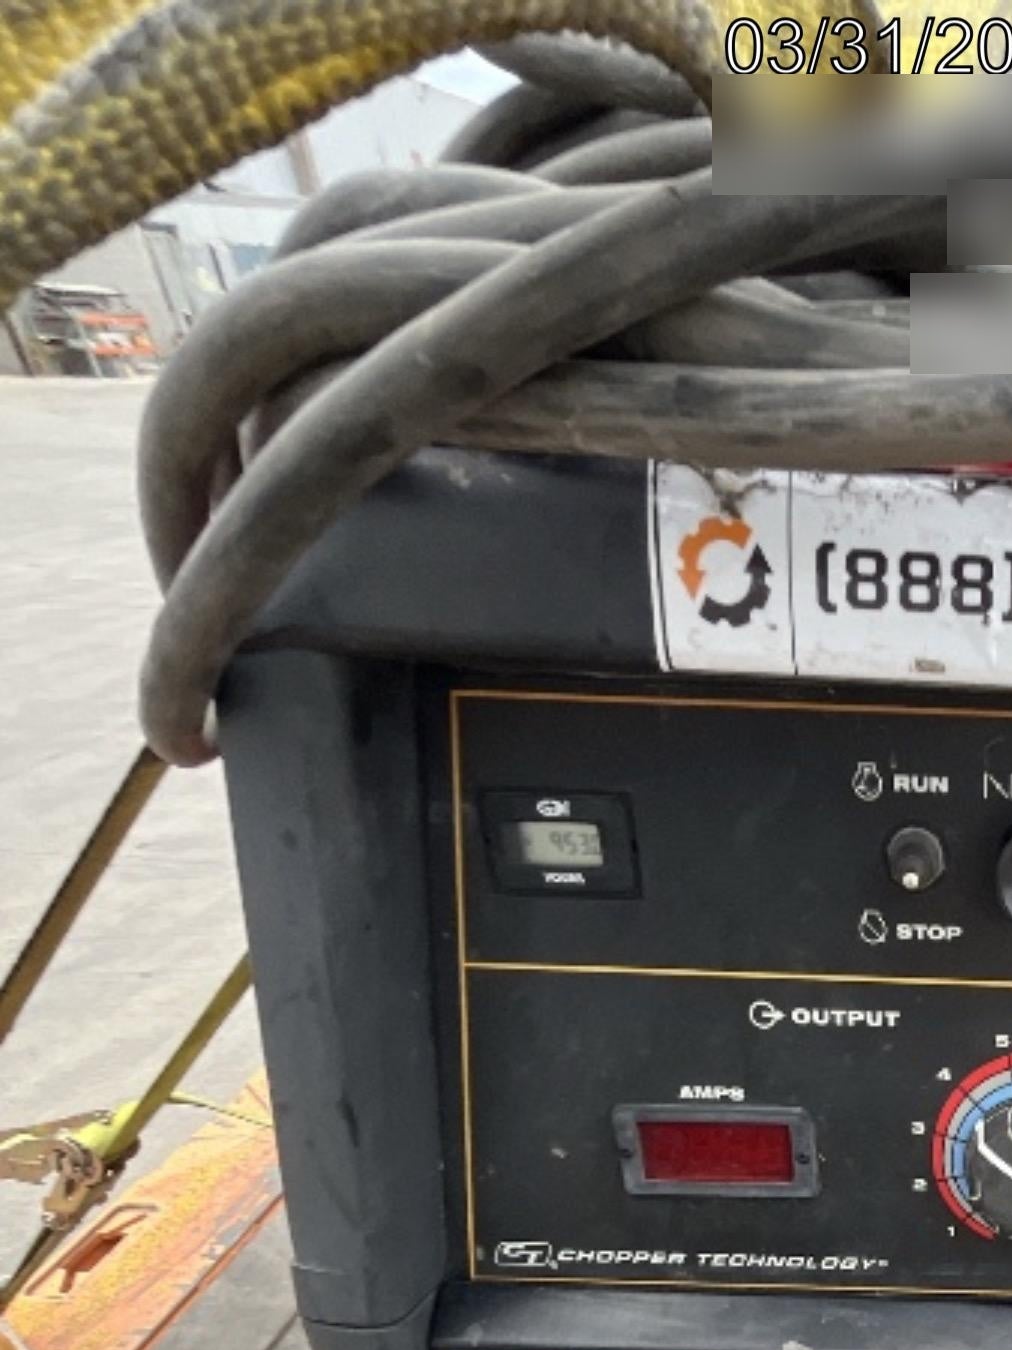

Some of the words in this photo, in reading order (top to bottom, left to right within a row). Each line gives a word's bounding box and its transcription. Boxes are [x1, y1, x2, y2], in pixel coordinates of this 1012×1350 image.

[893, 774, 950, 794] RUN
[896, 923, 964, 941] STOP
[791, 1007, 901, 1028] OUTPUT
[995, 1033, 1011, 1048] 5
[936, 1067, 952, 1081] 4
[678, 1085, 746, 1102] AMPS
[911, 1121, 926, 1136] 3
[912, 1178, 928, 1192] 2
[947, 1225, 956, 1238] 1
[557, 1247, 688, 1266] CHOPPER
